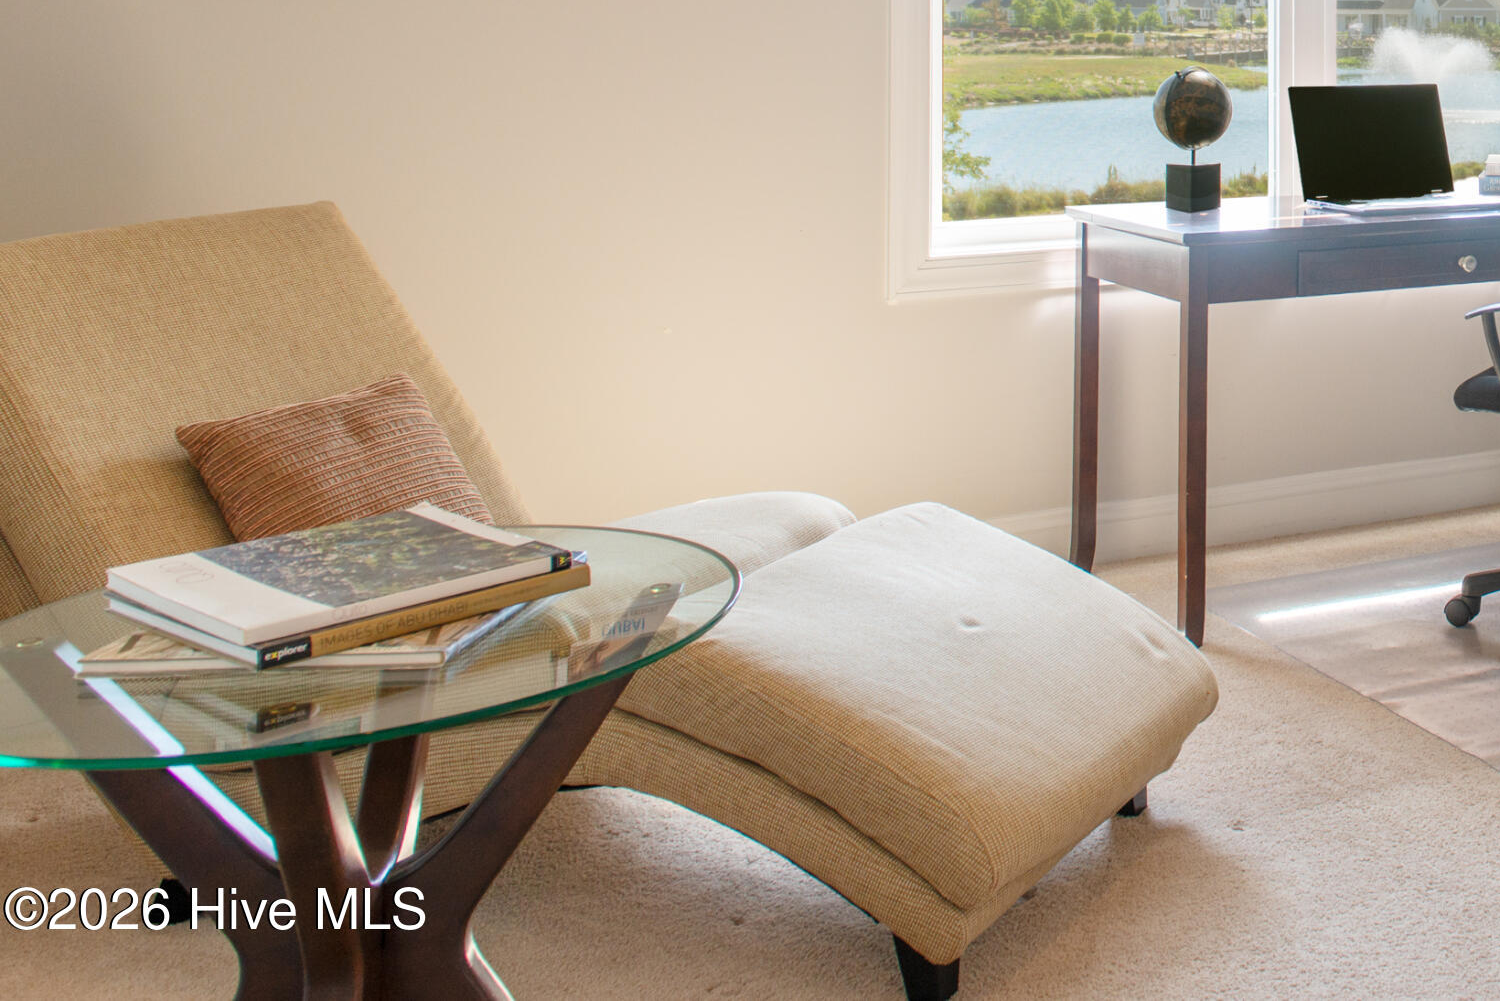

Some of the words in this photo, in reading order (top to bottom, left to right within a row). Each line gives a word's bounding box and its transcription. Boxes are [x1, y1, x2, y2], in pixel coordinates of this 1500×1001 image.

[319, 626, 374, 648] IMAGES
[375, 619, 397, 635] OF
[397, 610, 427, 629] ABU
[428, 602, 470, 623] DHABI
[264, 643, 309, 662] explorer
